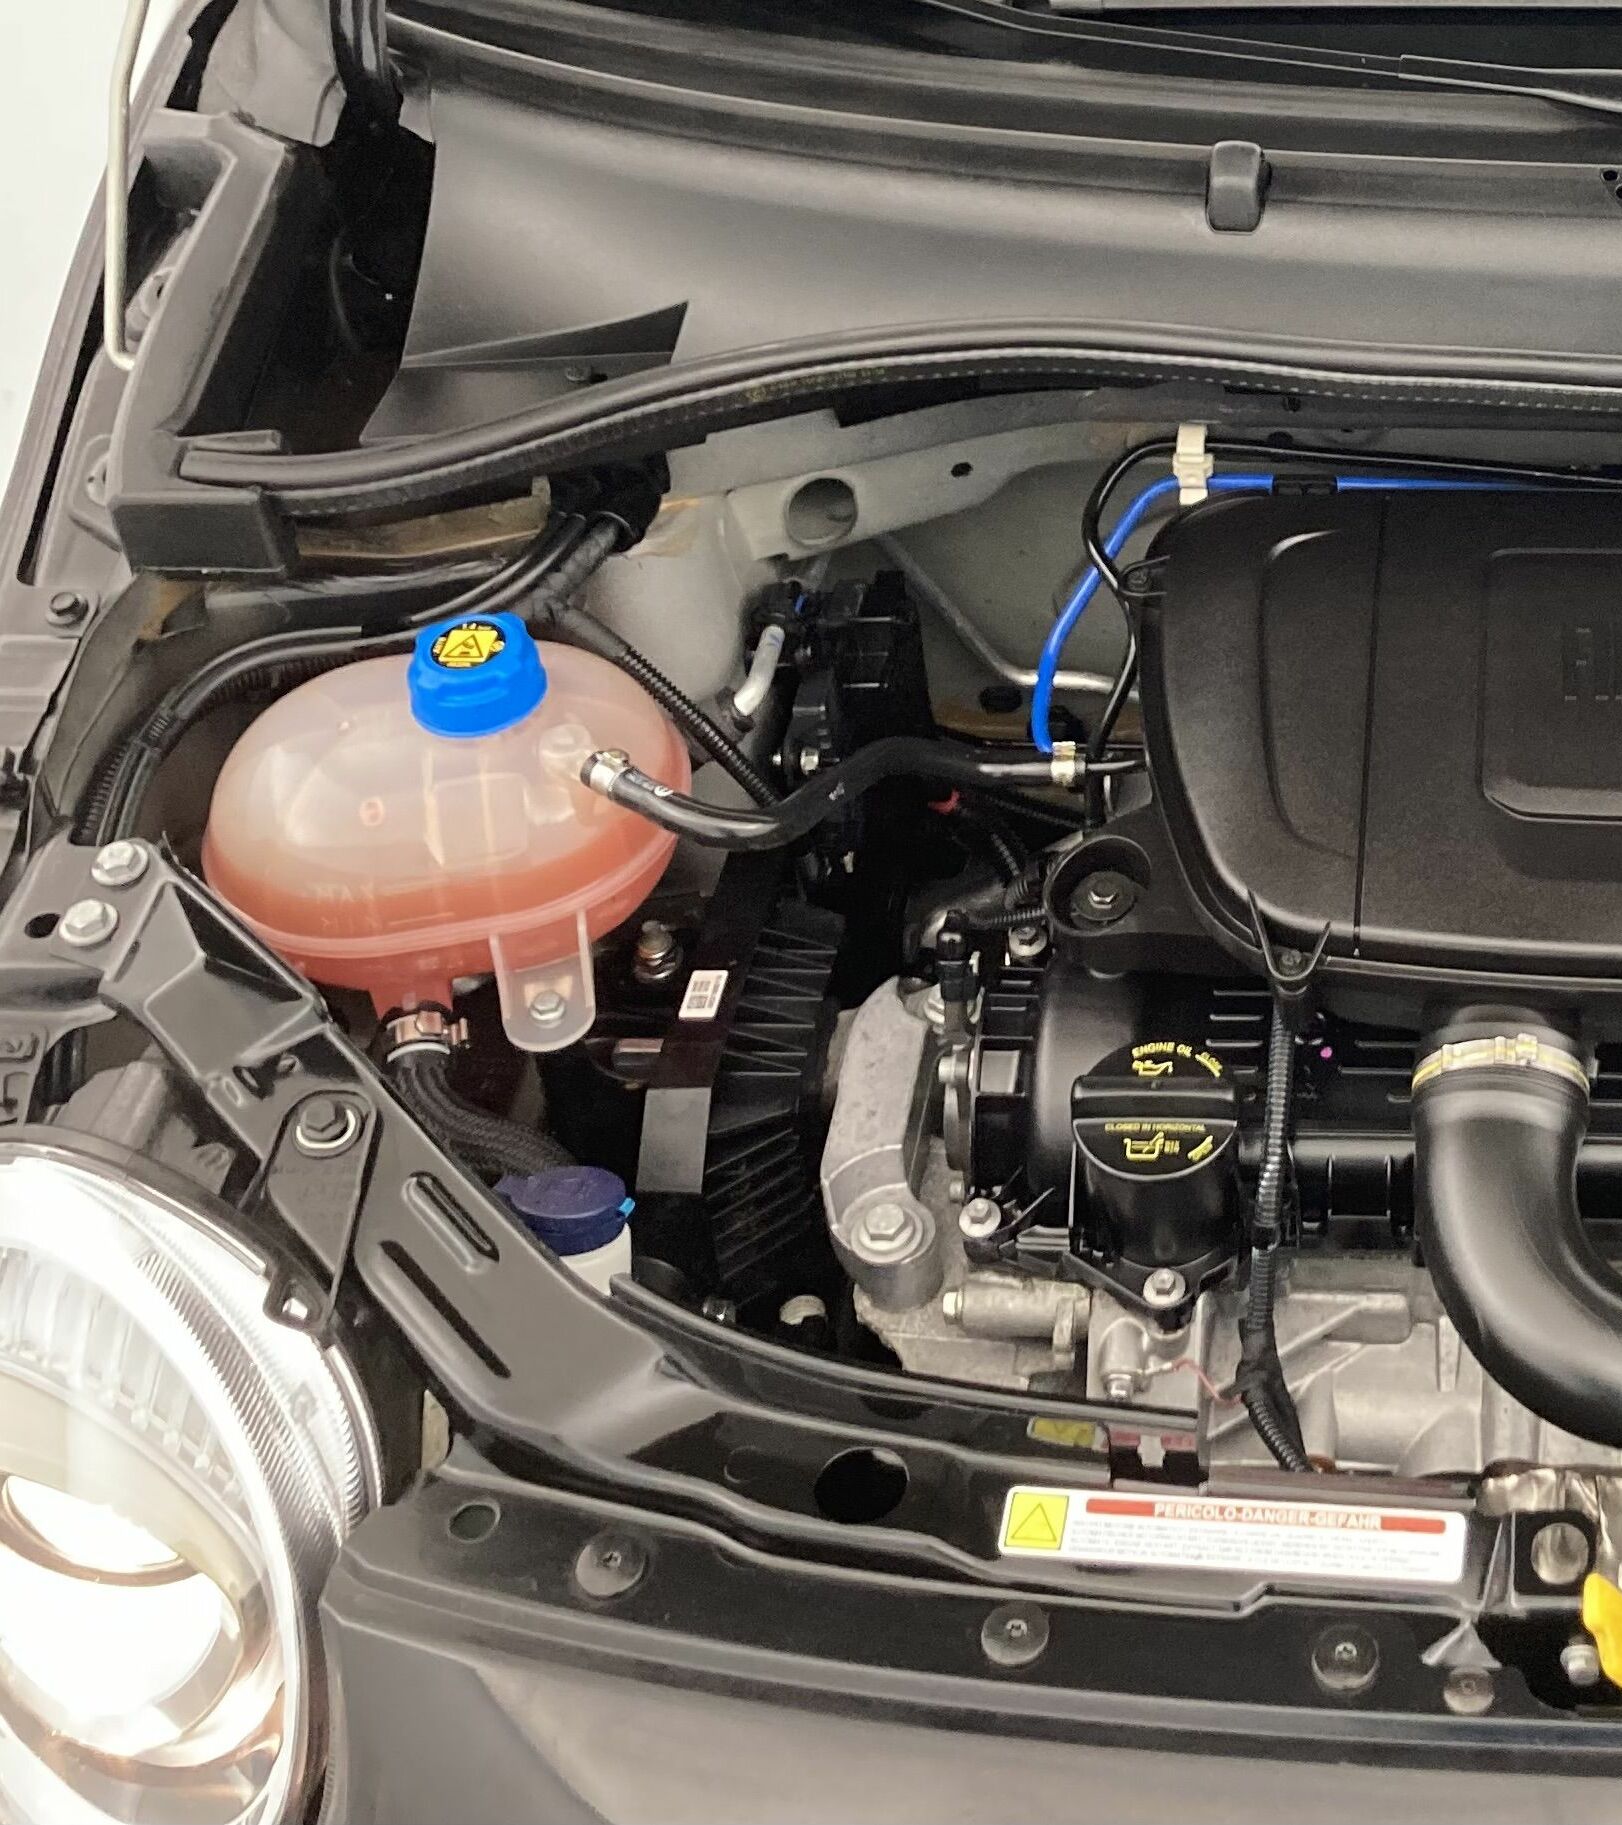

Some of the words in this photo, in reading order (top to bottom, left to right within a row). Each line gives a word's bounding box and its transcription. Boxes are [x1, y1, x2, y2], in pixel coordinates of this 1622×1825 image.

[1132, 1042, 1175, 1058] ENGINE
[1176, 1044, 1193, 1058] OIL
[1154, 1502, 1382, 1530] PERICOLO-DANGER-GEFAHR
